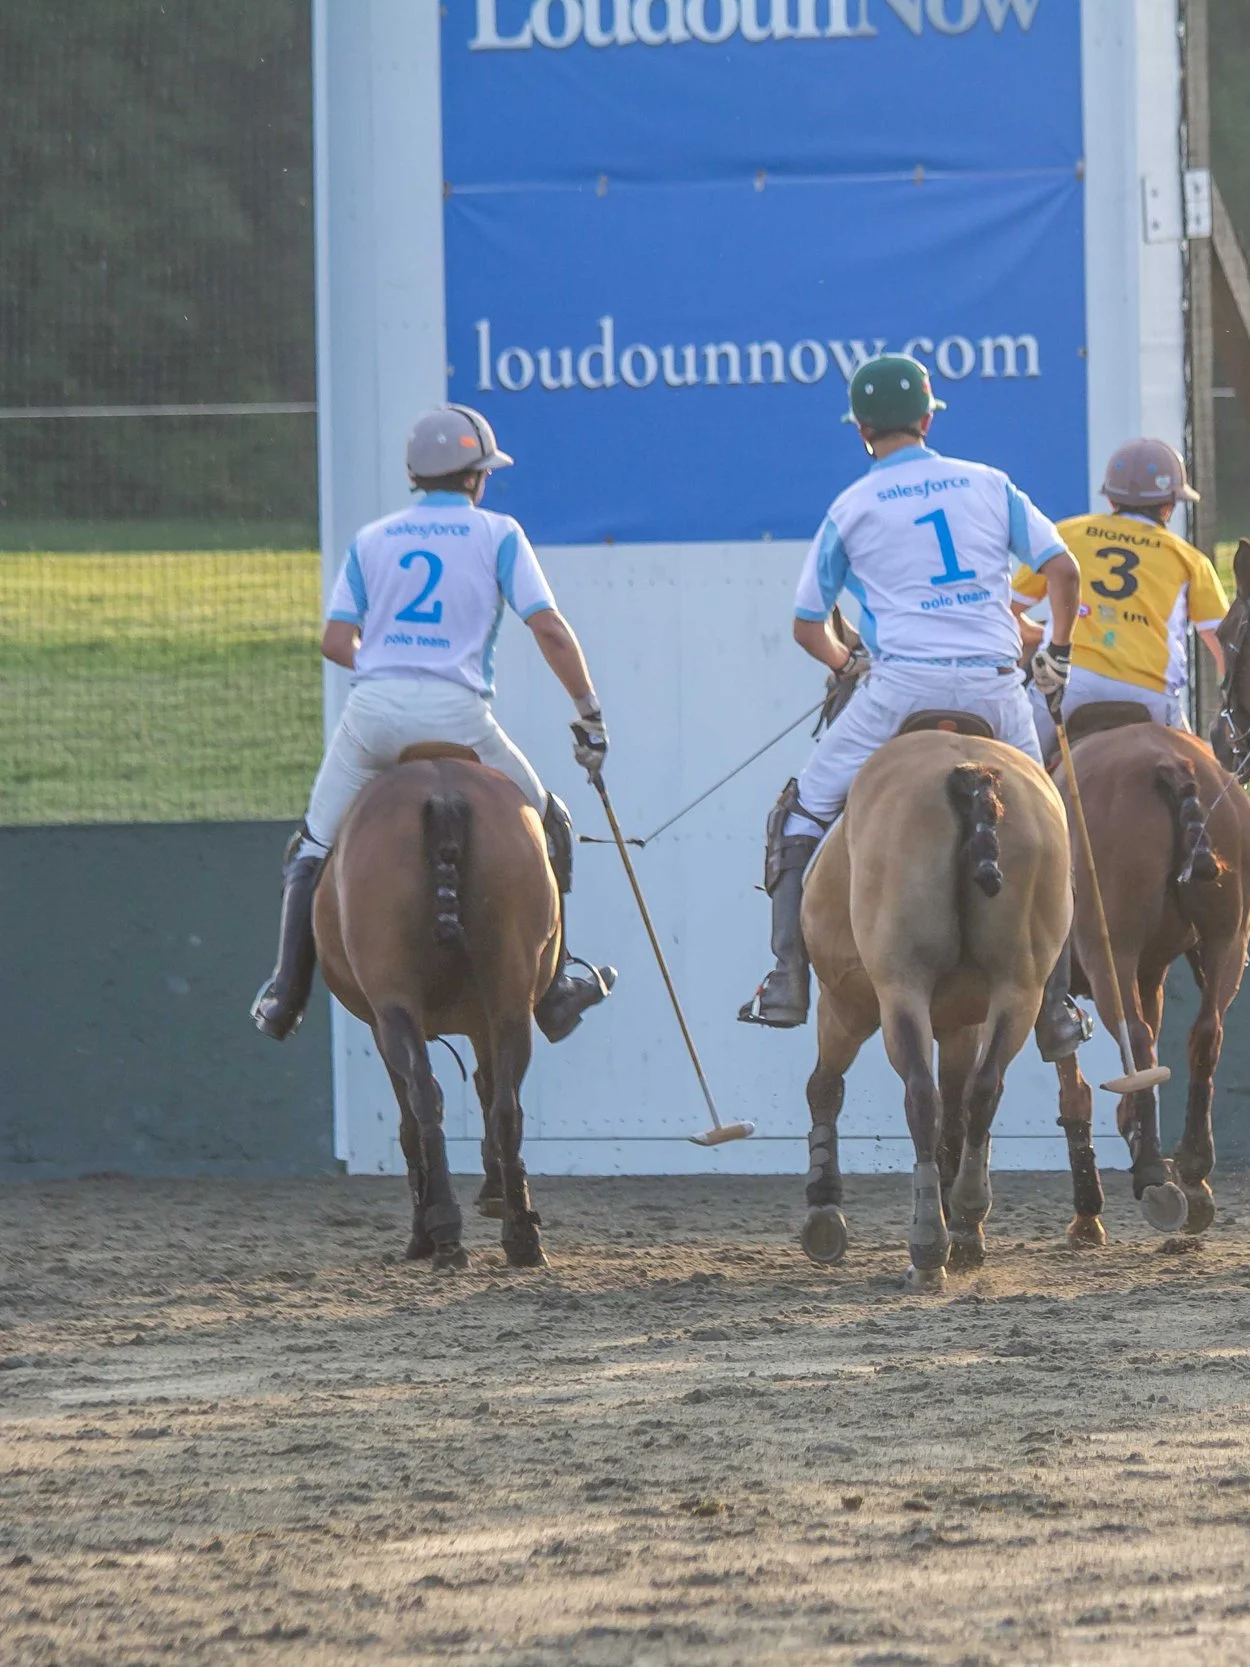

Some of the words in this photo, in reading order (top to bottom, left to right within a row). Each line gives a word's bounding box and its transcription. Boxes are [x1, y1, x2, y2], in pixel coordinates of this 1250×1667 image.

[475, 316, 1041, 391] loudounnowcom
[876, 475, 971, 502] salesforce
[385, 521, 471, 539] salesforce
[913, 508, 976, 586] 1
[394, 550, 444, 624] 2
[1090, 546, 1140, 601] 3
[956, 591, 991, 604] team
[384, 632, 413, 647] polo
[417, 634, 450, 649] team
